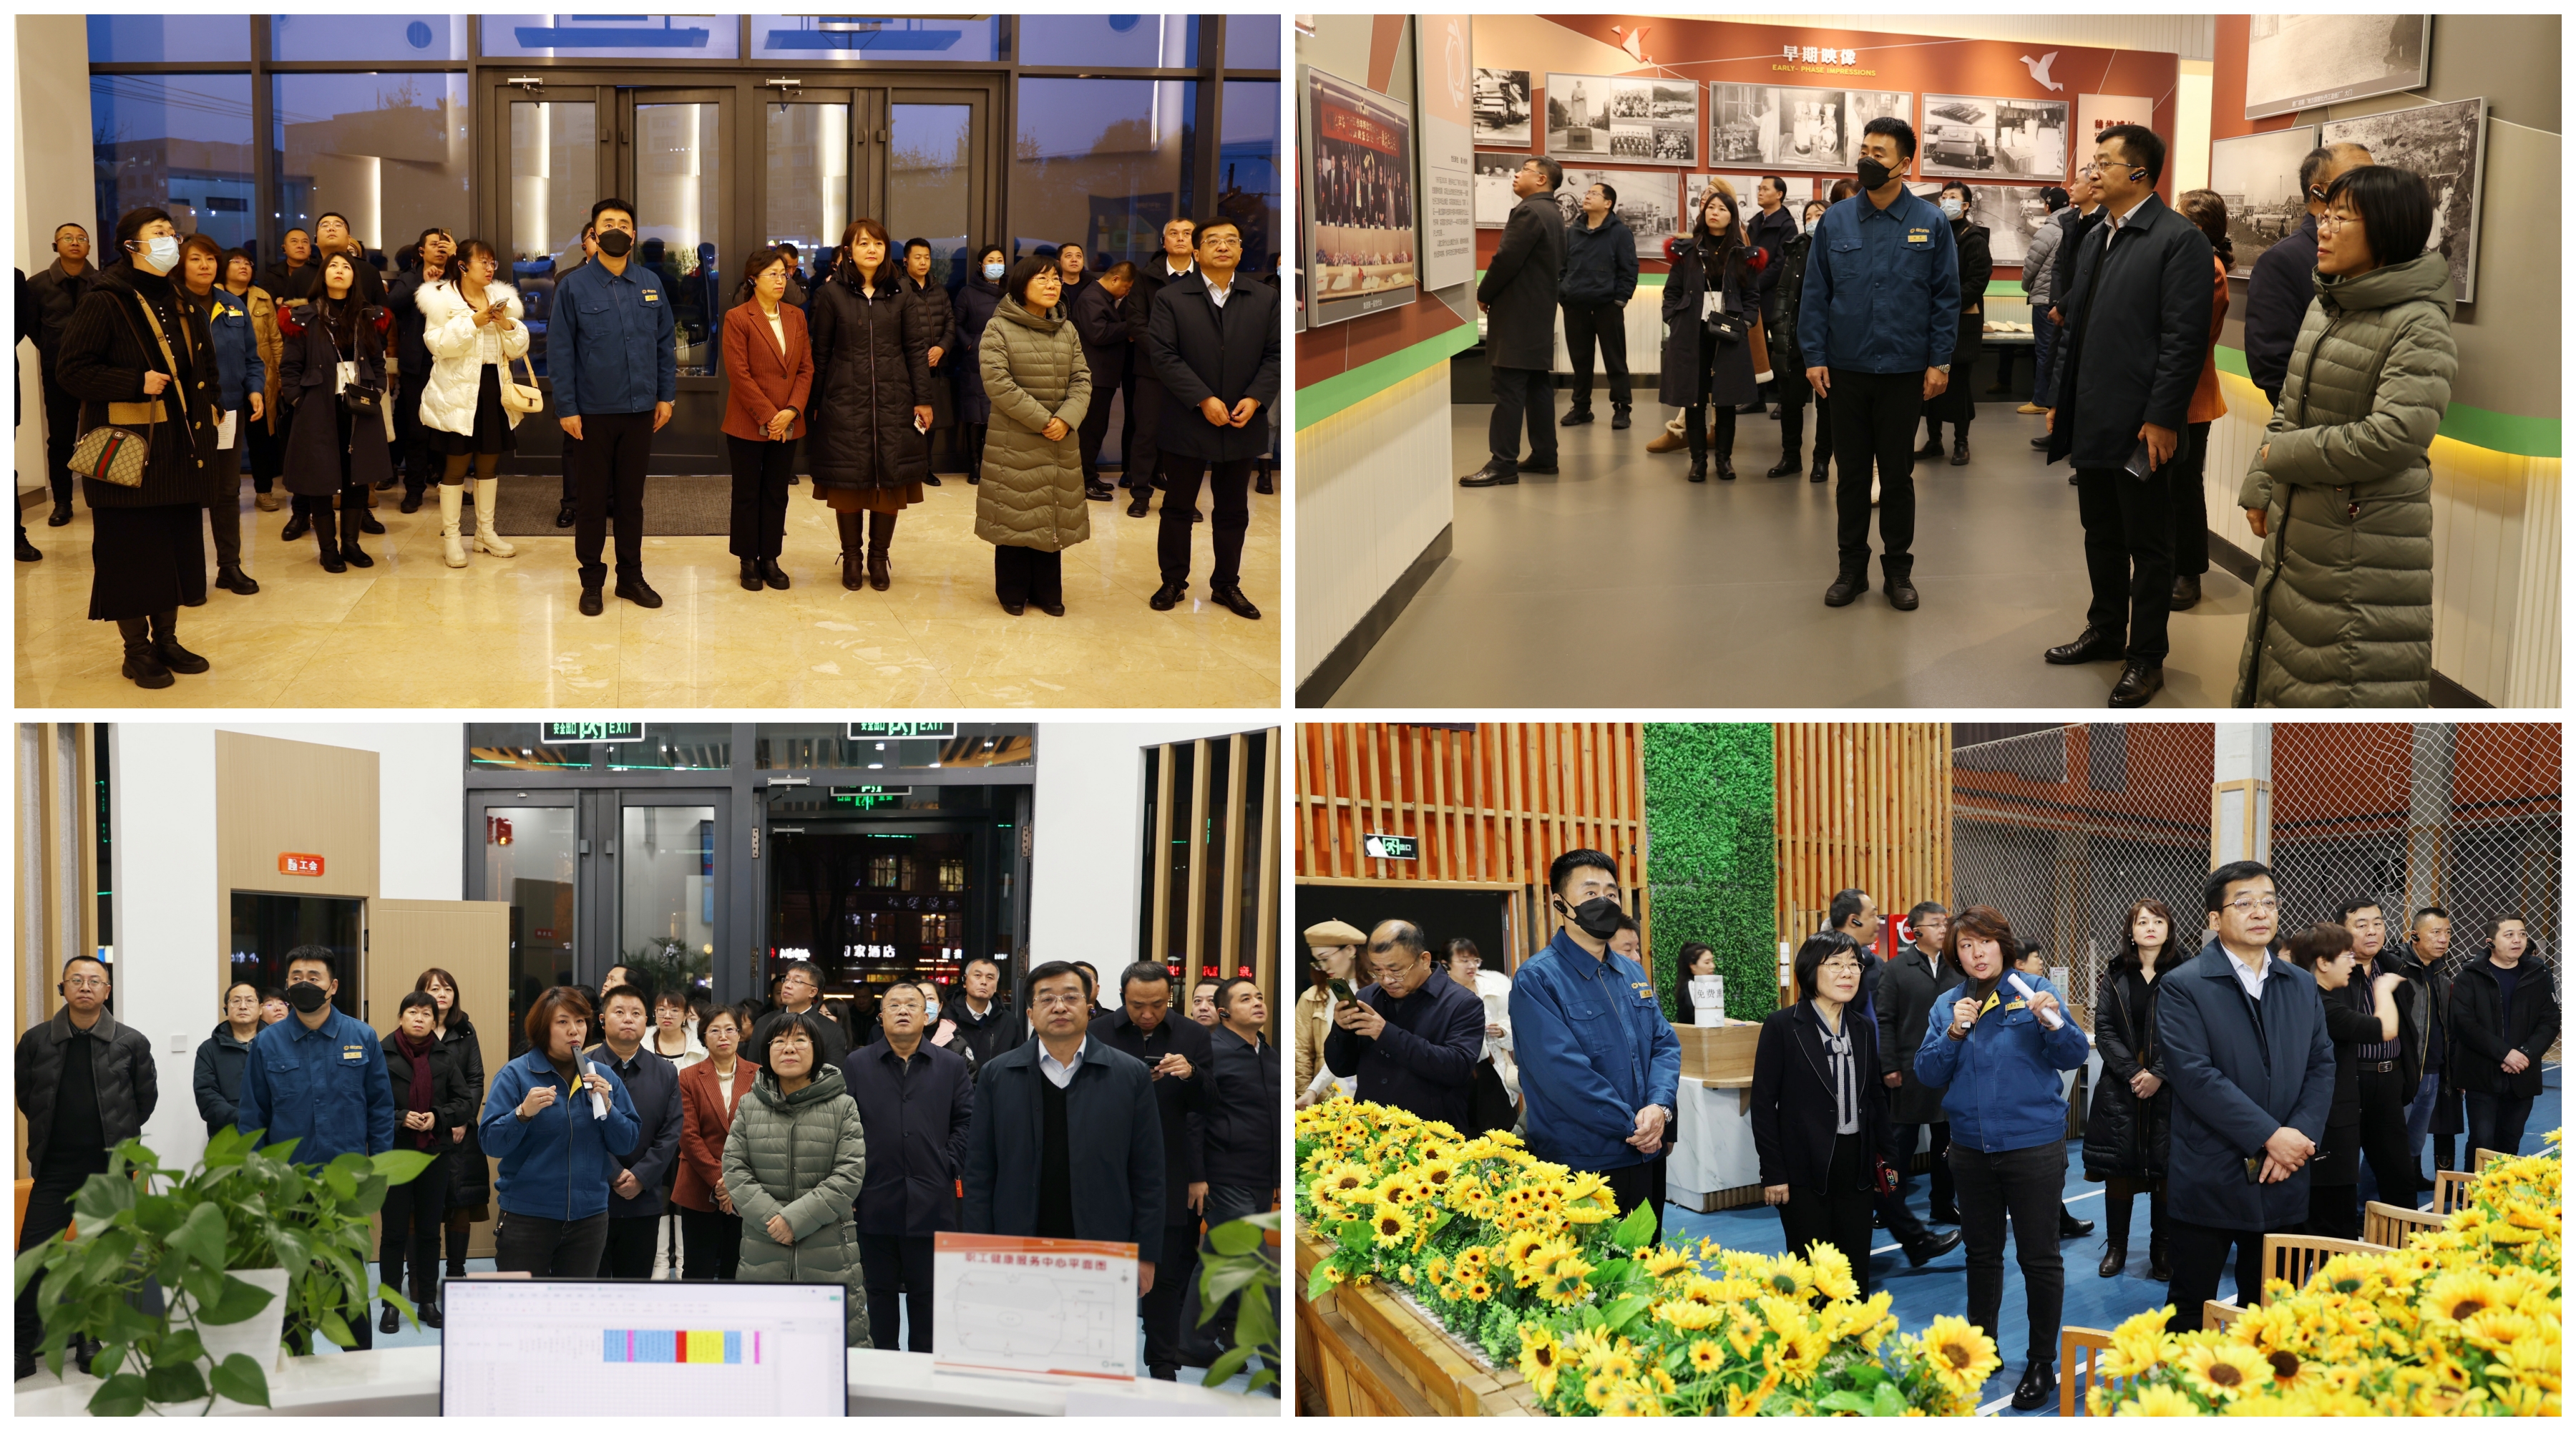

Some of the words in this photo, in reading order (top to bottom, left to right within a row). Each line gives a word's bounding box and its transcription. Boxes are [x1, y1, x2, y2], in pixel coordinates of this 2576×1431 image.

[1782, 44, 1856, 66] 早期映像
[1826, 67, 1876, 77] IMPRESSIONS
[553, 723, 577, 735] 安全出口
[609, 723, 632, 734] EXIT
[299, 860, 318, 871] 工会
[965, 1251, 1108, 1271] 职工健康服务中心平面图
